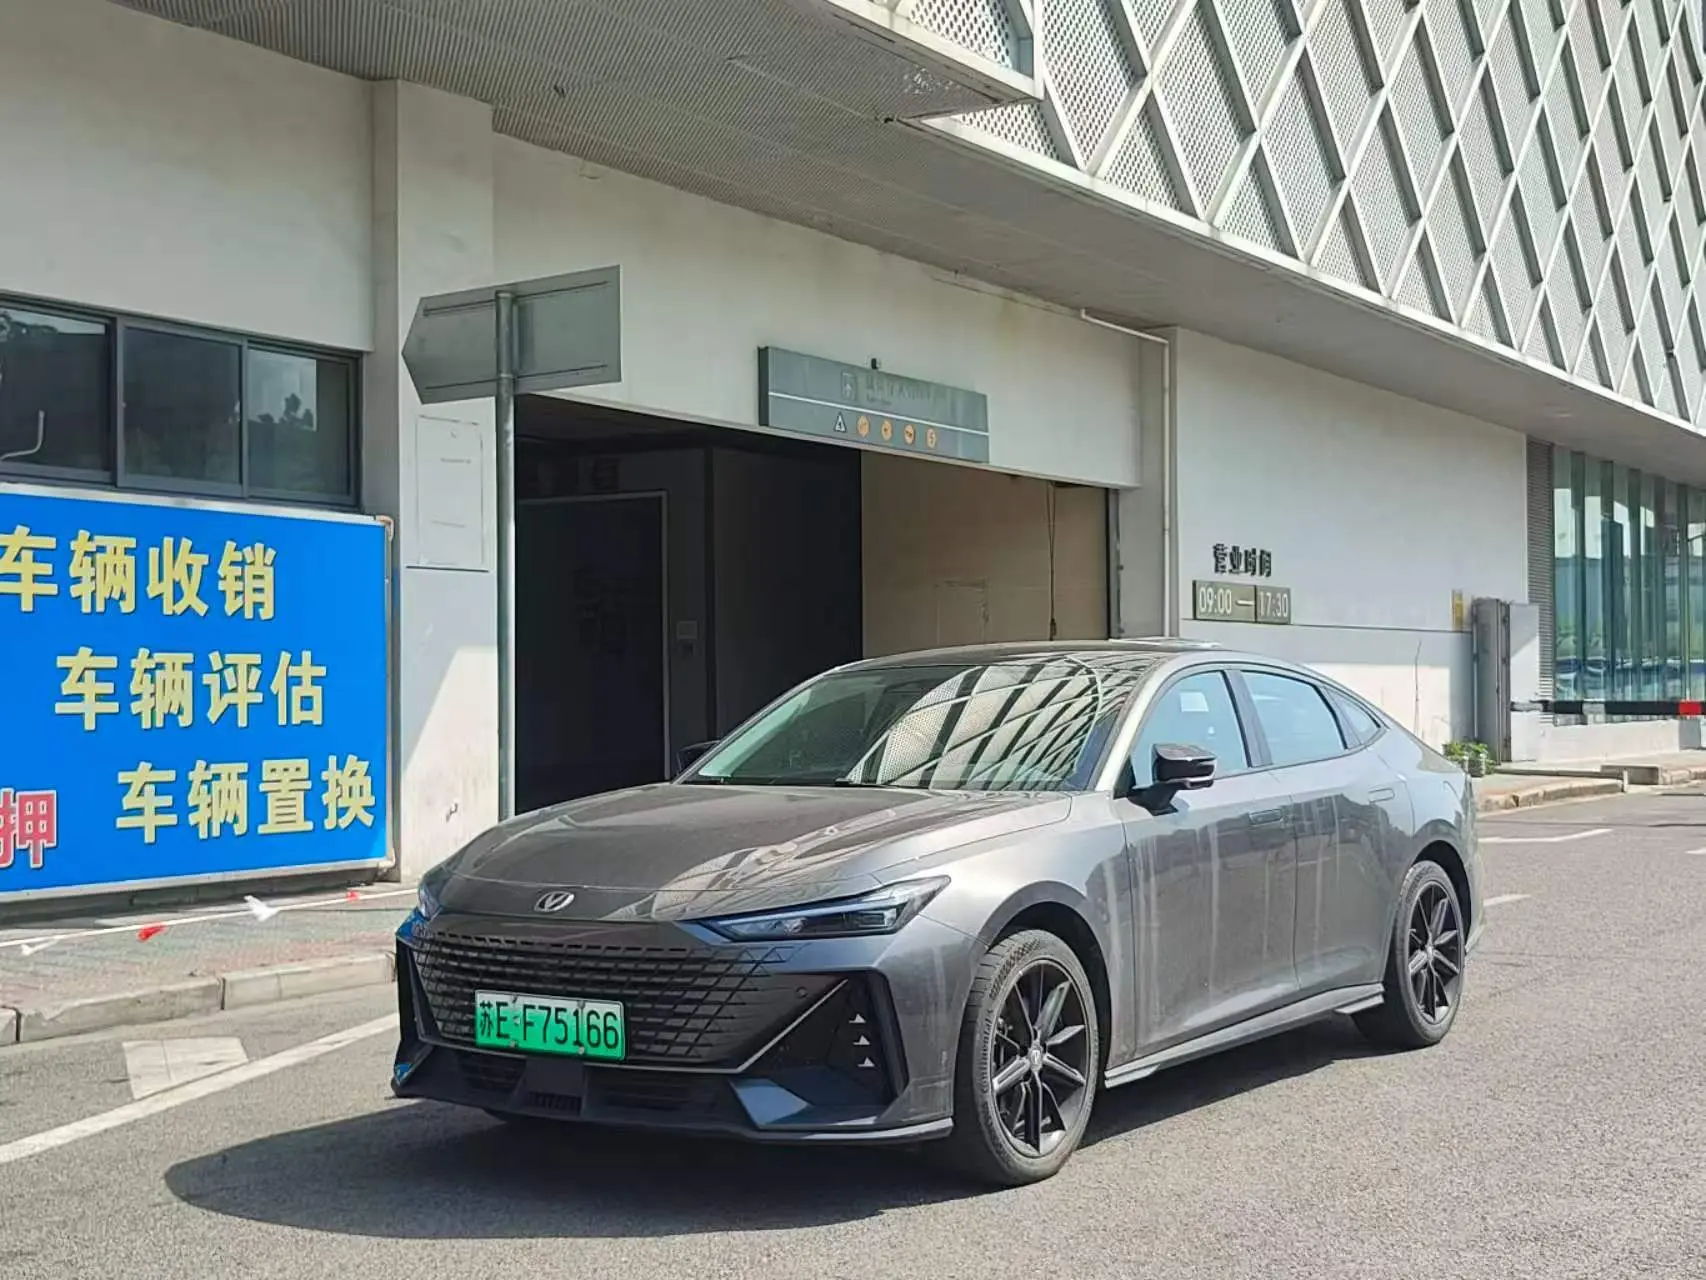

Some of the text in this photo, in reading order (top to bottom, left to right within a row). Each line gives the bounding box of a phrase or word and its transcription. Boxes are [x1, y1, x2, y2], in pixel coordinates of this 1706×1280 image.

[0, 525, 276, 619] 车辆收销
[1199, 587, 1231, 614] 09:00
[1260, 592, 1288, 617] 17:30
[55, 647, 326, 730] 车辆评估
[116, 754, 375, 843] 车辆置换
